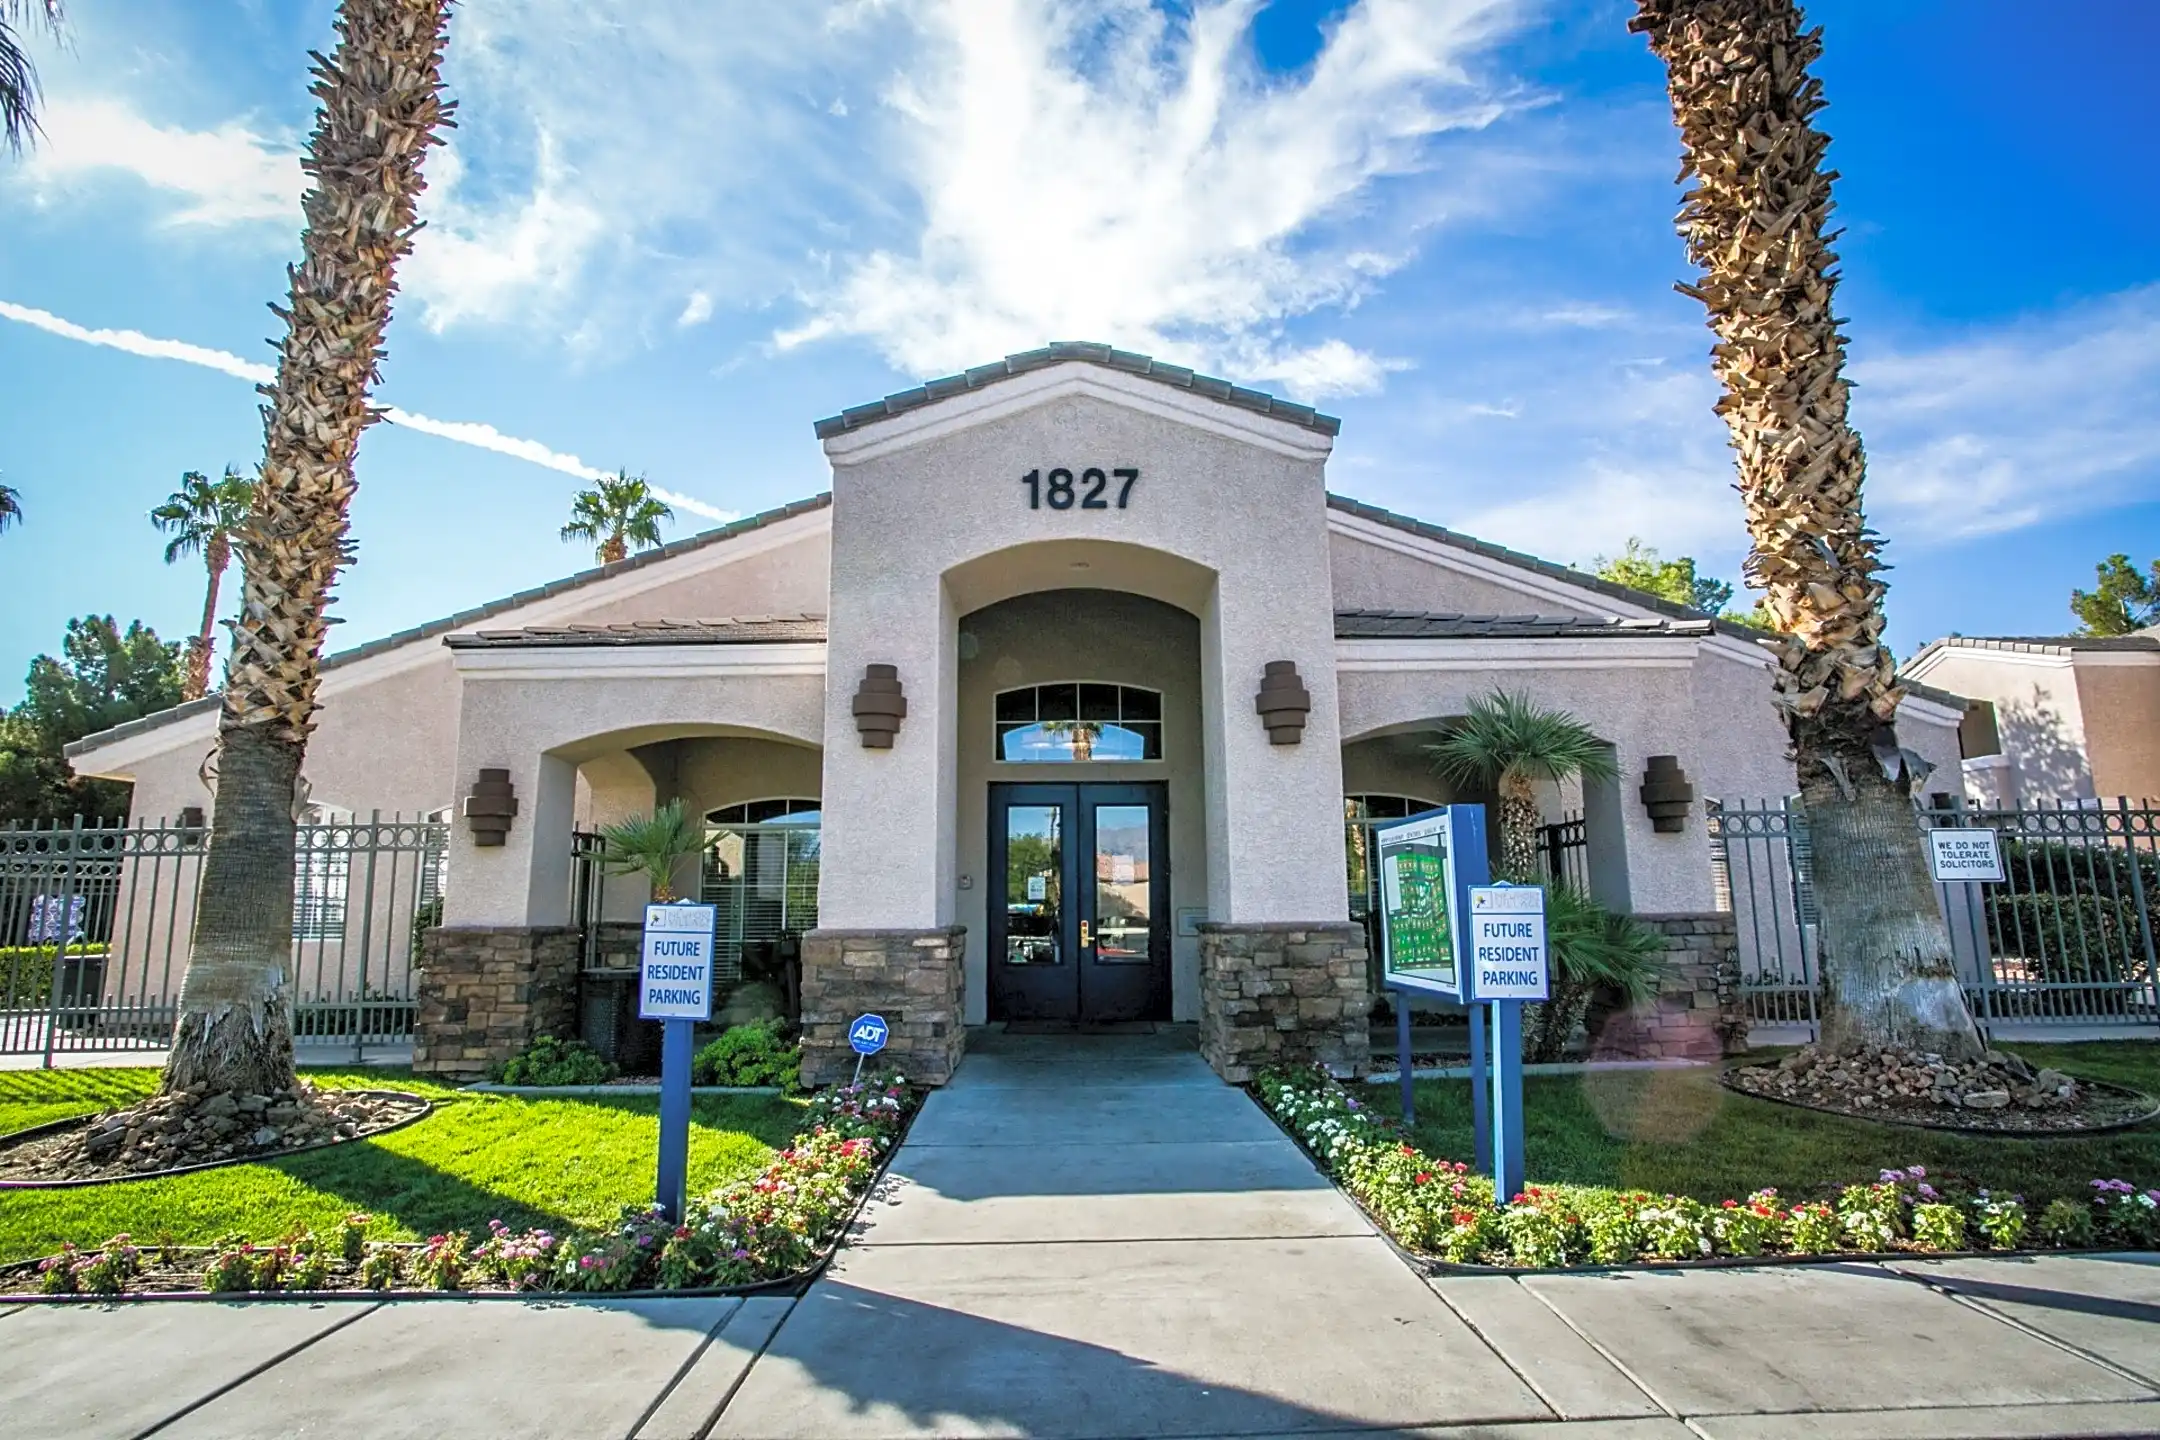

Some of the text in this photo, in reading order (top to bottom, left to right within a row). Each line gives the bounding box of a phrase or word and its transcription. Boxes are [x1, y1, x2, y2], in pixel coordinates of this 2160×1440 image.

[1022, 467, 1139, 510] 1827
[1938, 841, 1990, 850] WE DO NOT
[1941, 851, 1990, 859] TOLERATE
[1940, 860, 1995, 869] SOLICITORS
[1484, 923, 1533, 938] FUTURE
[654, 941, 701, 956] FUTURE
[1479, 946, 1539, 962] RESIDENT
[647, 964, 705, 981] RESIDENT
[1483, 970, 1538, 986] PARKING
[649, 988, 701, 1005] PARKING
[853, 1024, 885, 1043] ADT
